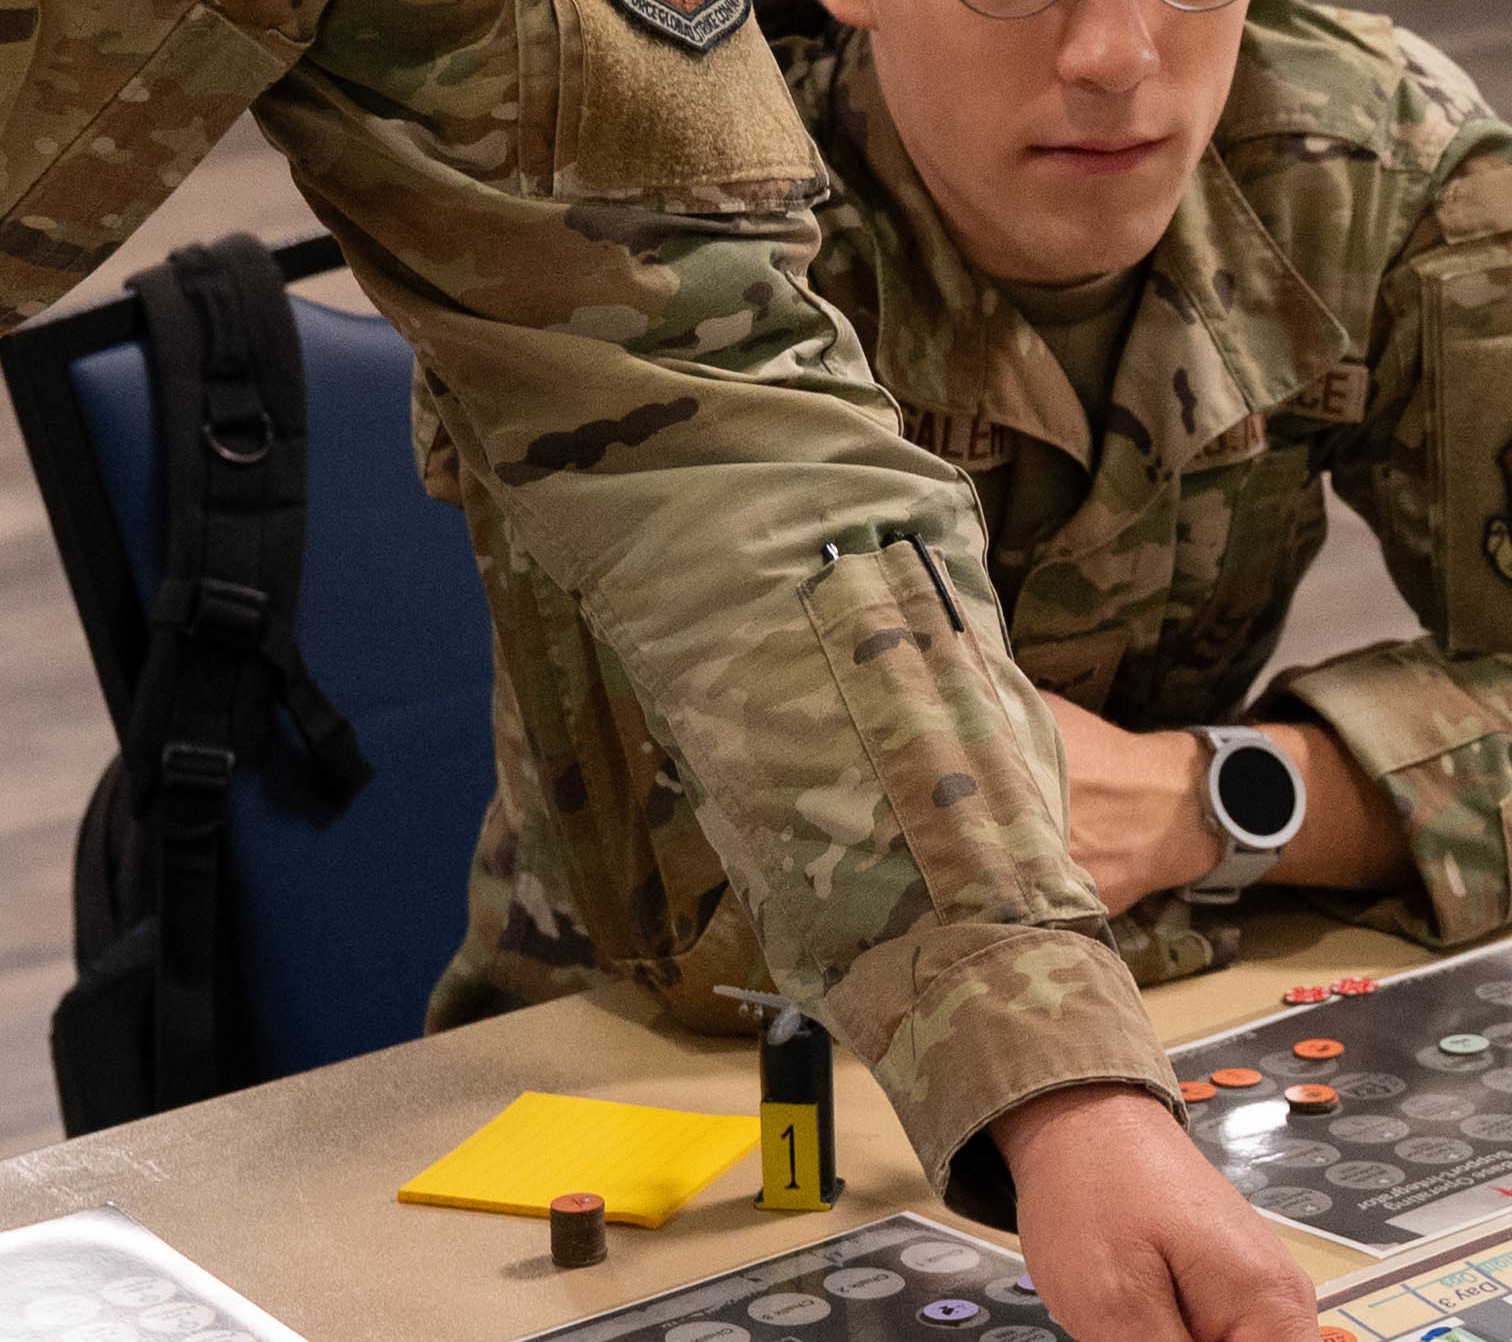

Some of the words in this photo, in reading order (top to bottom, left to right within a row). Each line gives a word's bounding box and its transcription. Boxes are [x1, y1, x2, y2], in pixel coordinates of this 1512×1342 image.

[778, 1124, 802, 1190] 1
[1455, 1279, 1499, 1301] Day
[1438, 1296, 1453, 1309] 3
